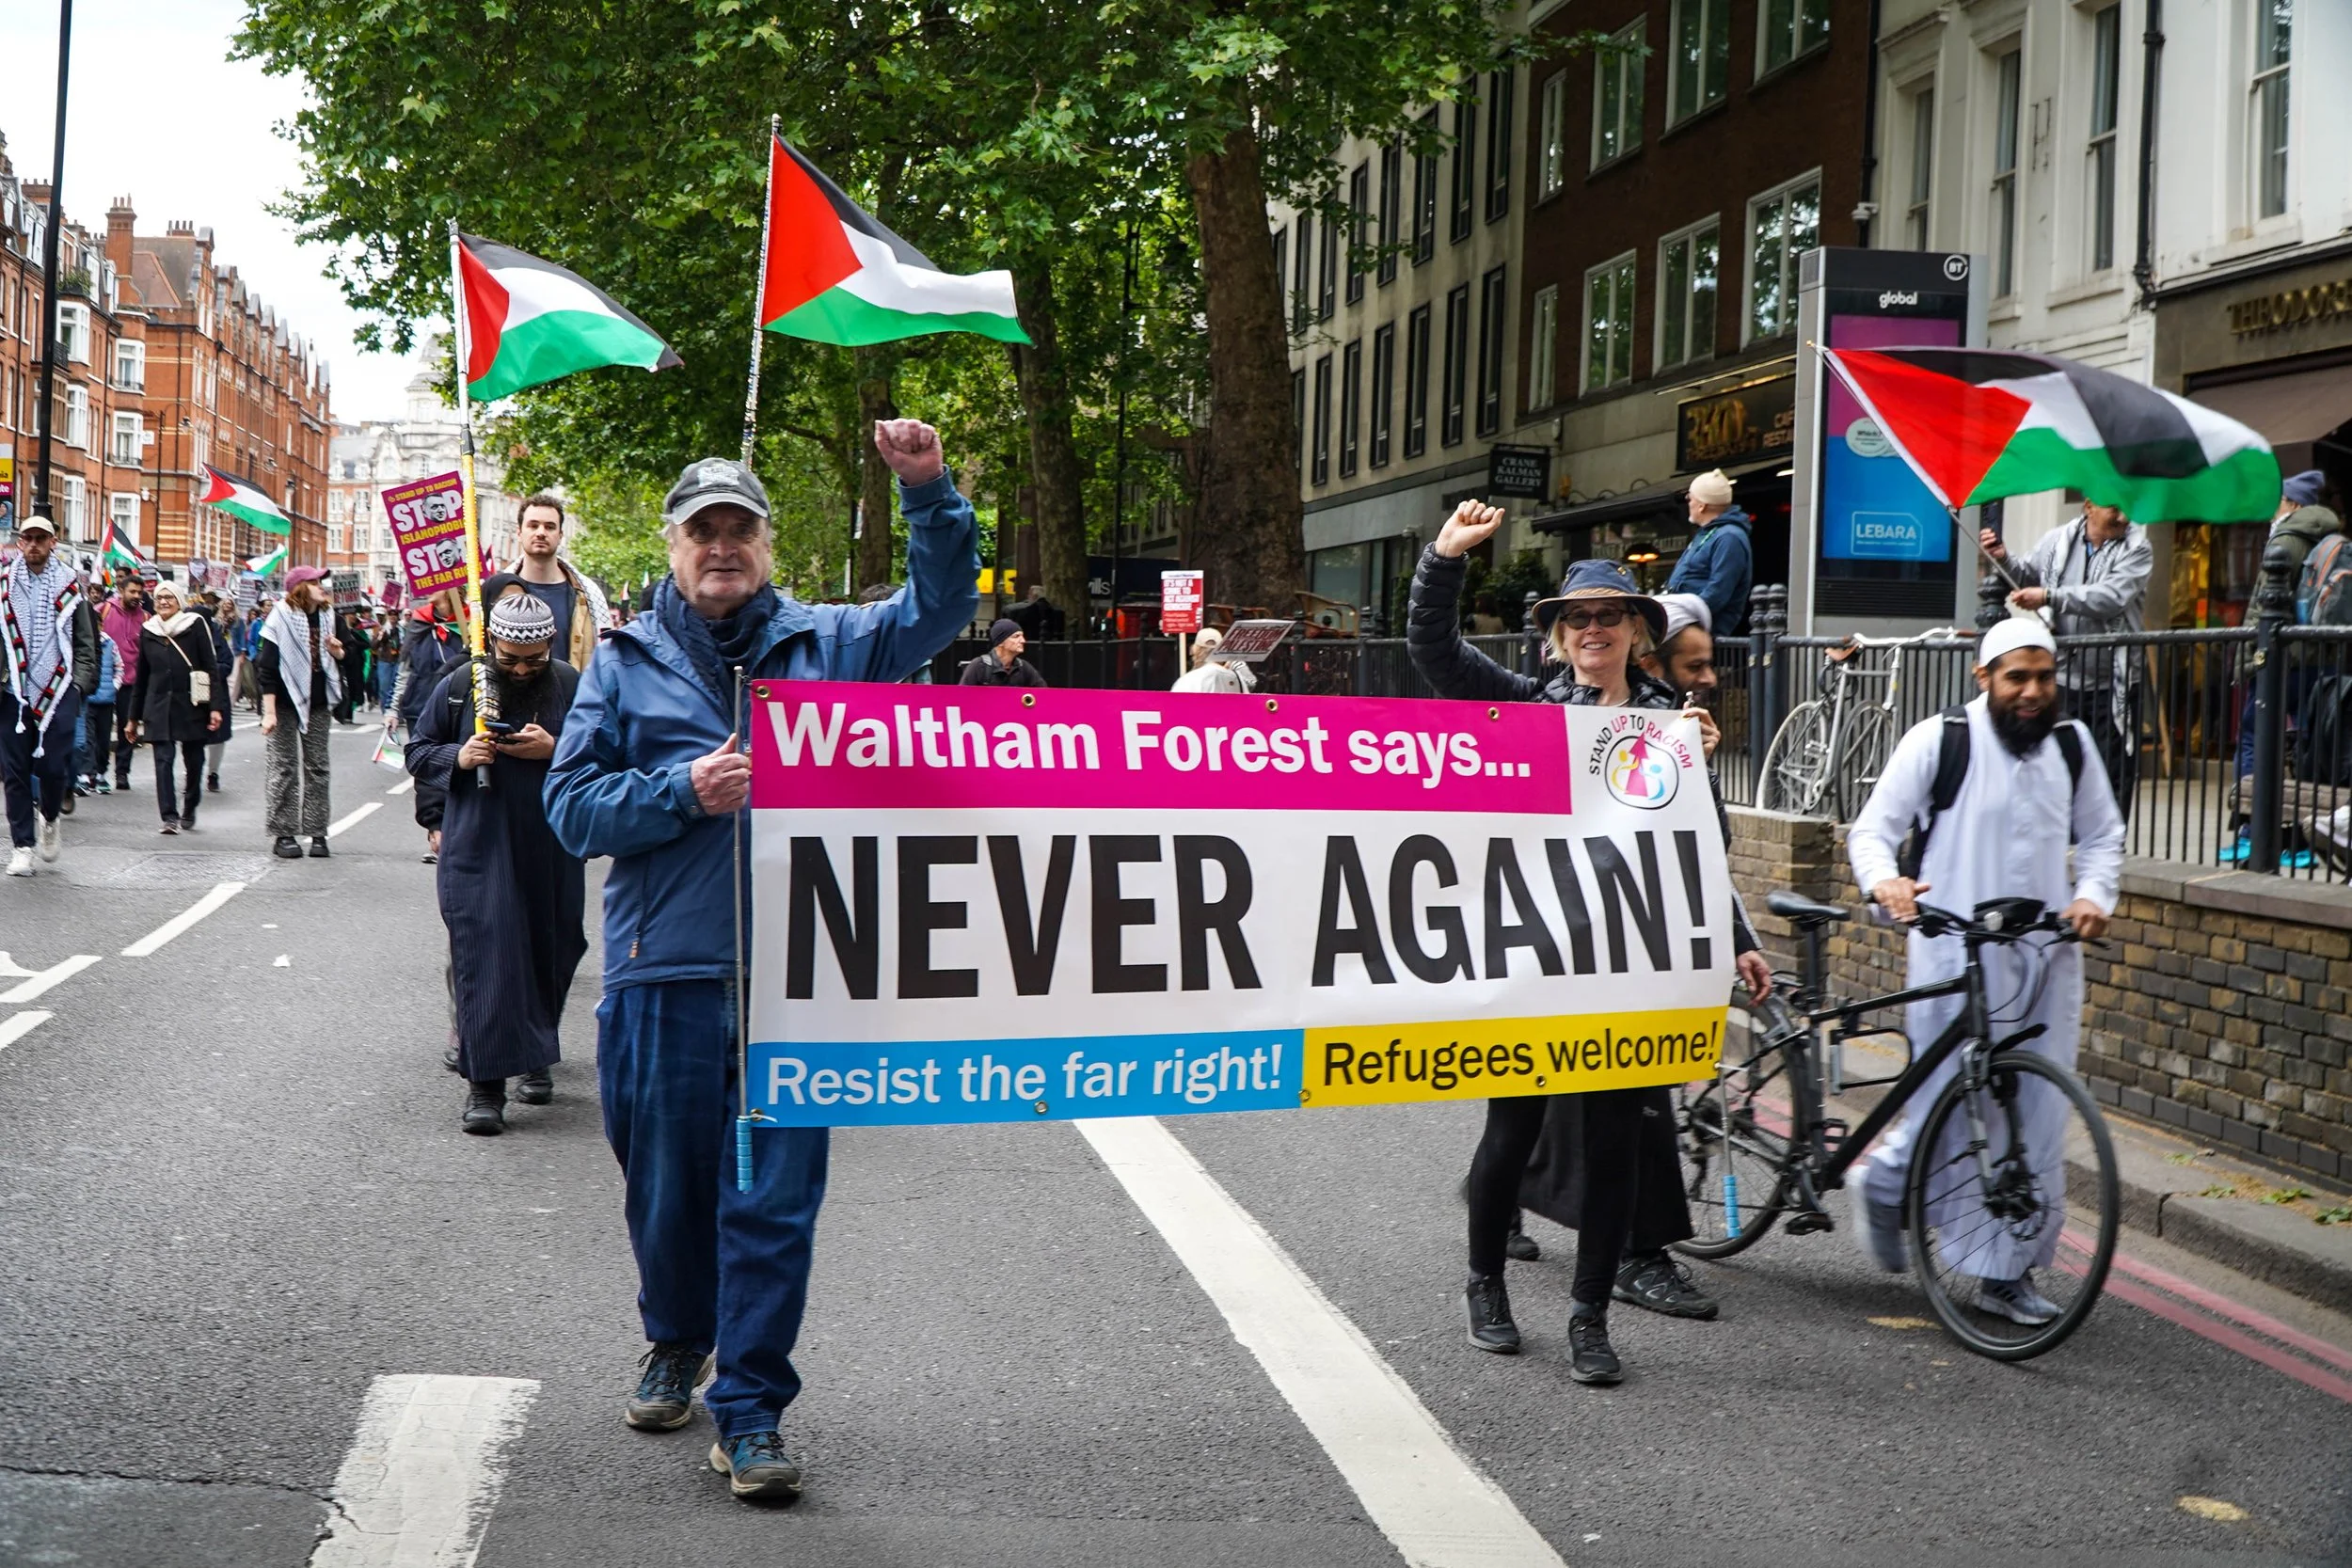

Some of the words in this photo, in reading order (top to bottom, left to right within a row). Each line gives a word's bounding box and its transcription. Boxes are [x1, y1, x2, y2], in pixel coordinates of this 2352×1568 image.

[1948, 262, 1963, 273] BT
[1879, 290, 1917, 309] global
[1497, 466, 1541, 478] KALMAN
[1502, 457, 1537, 467] CRANE
[395, 490, 416, 501] STAND
[434, 478, 458, 490] RACISM
[1495, 475, 1543, 486] GALLERY
[1856, 523, 1916, 539] LEBARA
[414, 578, 435, 590] THE
[434, 570, 453, 584] FAR
[767, 702, 1101, 769] Waltham
[1120, 709, 1333, 775] Forest
[1348, 730, 1531, 790] says...
[1589, 727, 1613, 775] STAND
[1611, 715, 1628, 734] UP
[1629, 715, 1645, 730] TO
[1646, 721, 1693, 768] RACISM
[786, 834, 1263, 1000] NEVER
[1311, 830, 1712, 988] AGAIN!
[1323, 1037, 1534, 1091] Refugees
[1547, 1021, 1719, 1074] welcome!
[767, 1056, 942, 1105] Resist
[958, 1054, 1046, 1101] the
[1062, 1051, 1138, 1100] far
[1152, 1043, 1283, 1104] right!
